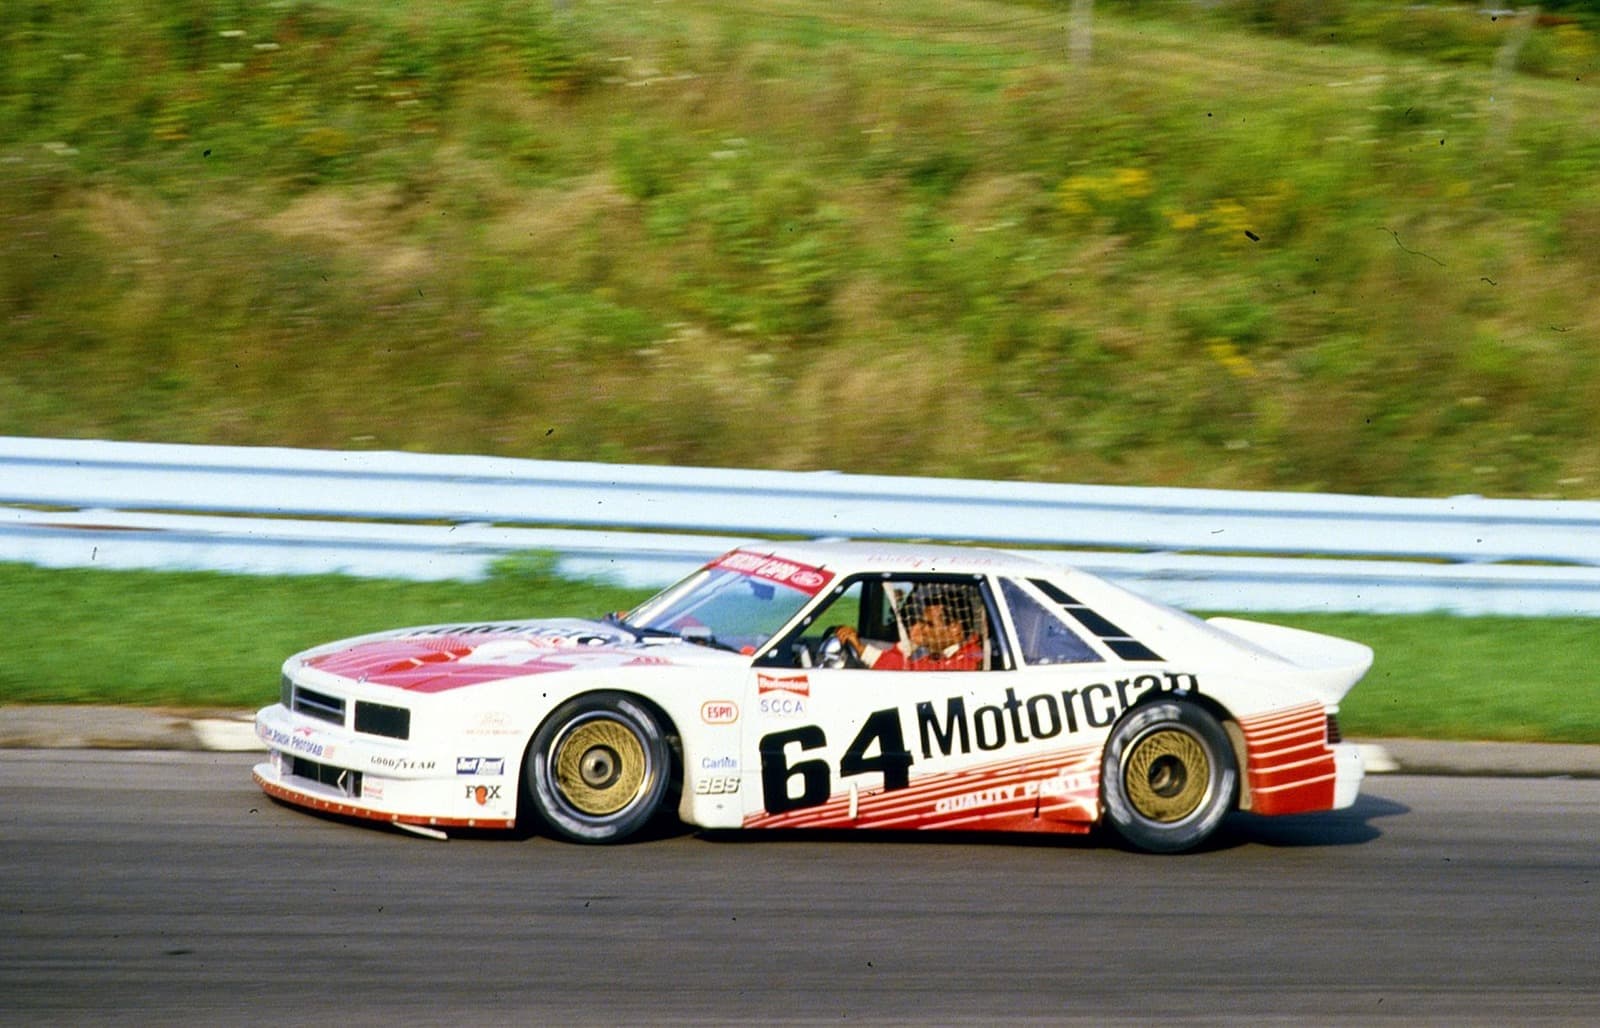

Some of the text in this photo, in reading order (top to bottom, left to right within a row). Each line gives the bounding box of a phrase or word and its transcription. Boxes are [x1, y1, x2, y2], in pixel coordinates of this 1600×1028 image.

[707, 706, 732, 719] ESPN
[760, 699, 804, 713] SCCA
[759, 707, 914, 815] 64
[915, 672, 1199, 760] Motorcra
[696, 777, 741, 795] BBS
[935, 785, 1019, 813] QUALITY
